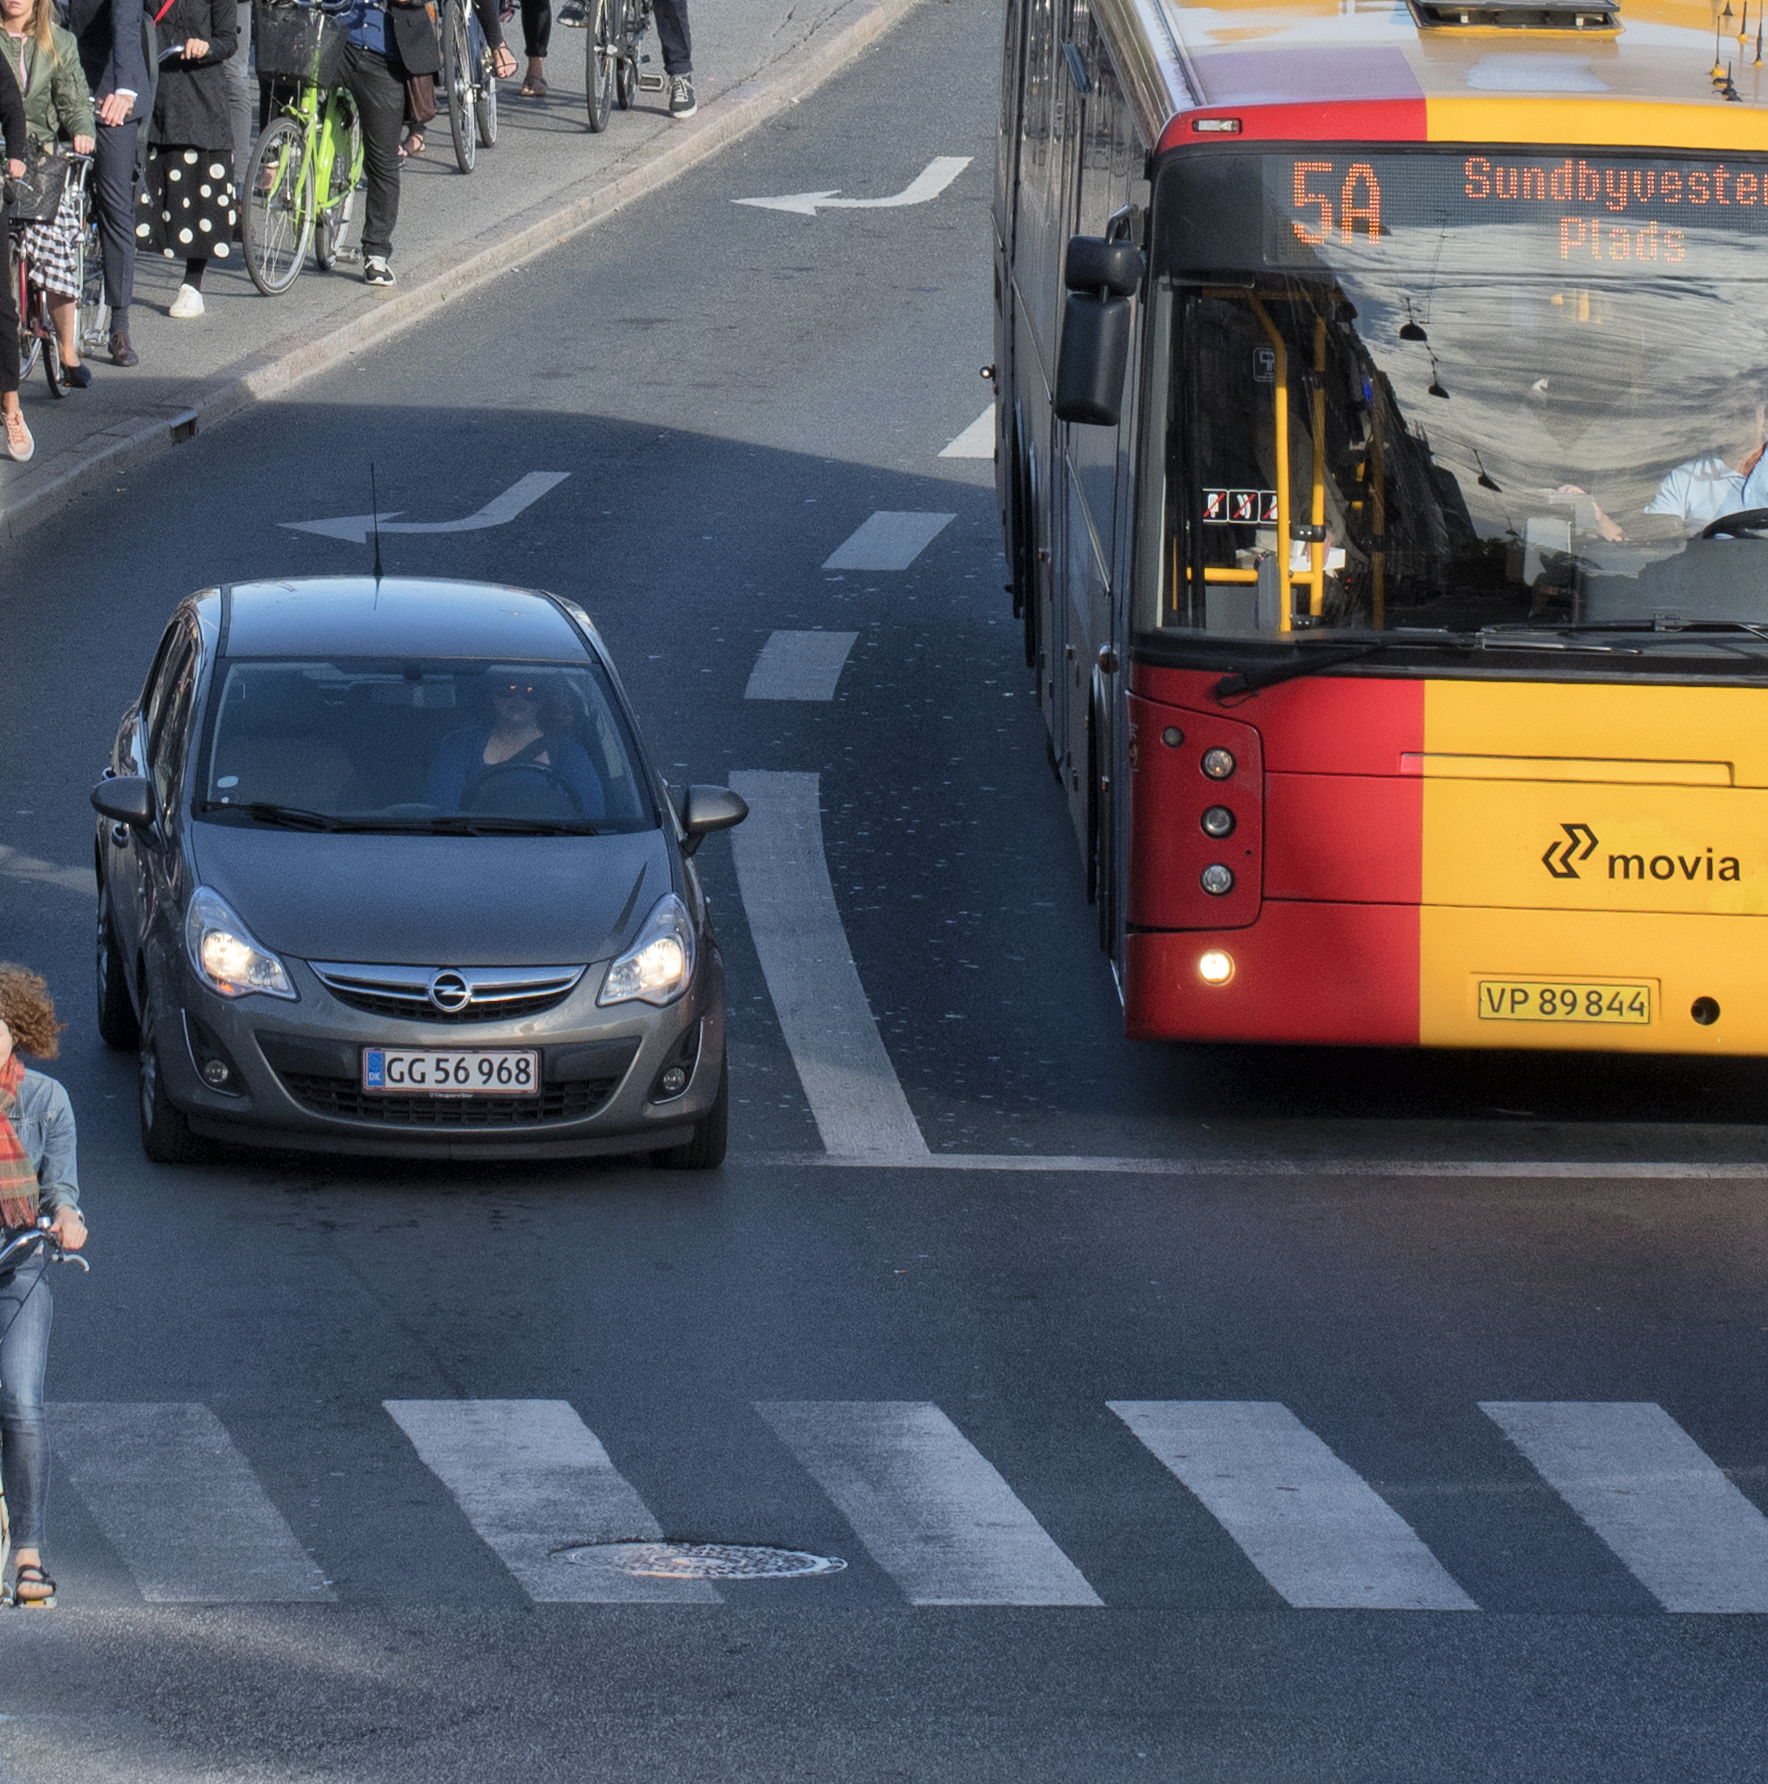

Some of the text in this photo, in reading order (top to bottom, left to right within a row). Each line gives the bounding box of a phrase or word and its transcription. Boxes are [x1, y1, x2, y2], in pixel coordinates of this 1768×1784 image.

[1292, 160, 1382, 246] 5A
[1559, 219, 1687, 263] Plads
[1607, 851, 1742, 883] movia
[1486, 988, 1529, 1014] VP
[368, 1072, 381, 1081] DK
[385, 1057, 532, 1086] GG 56 968
